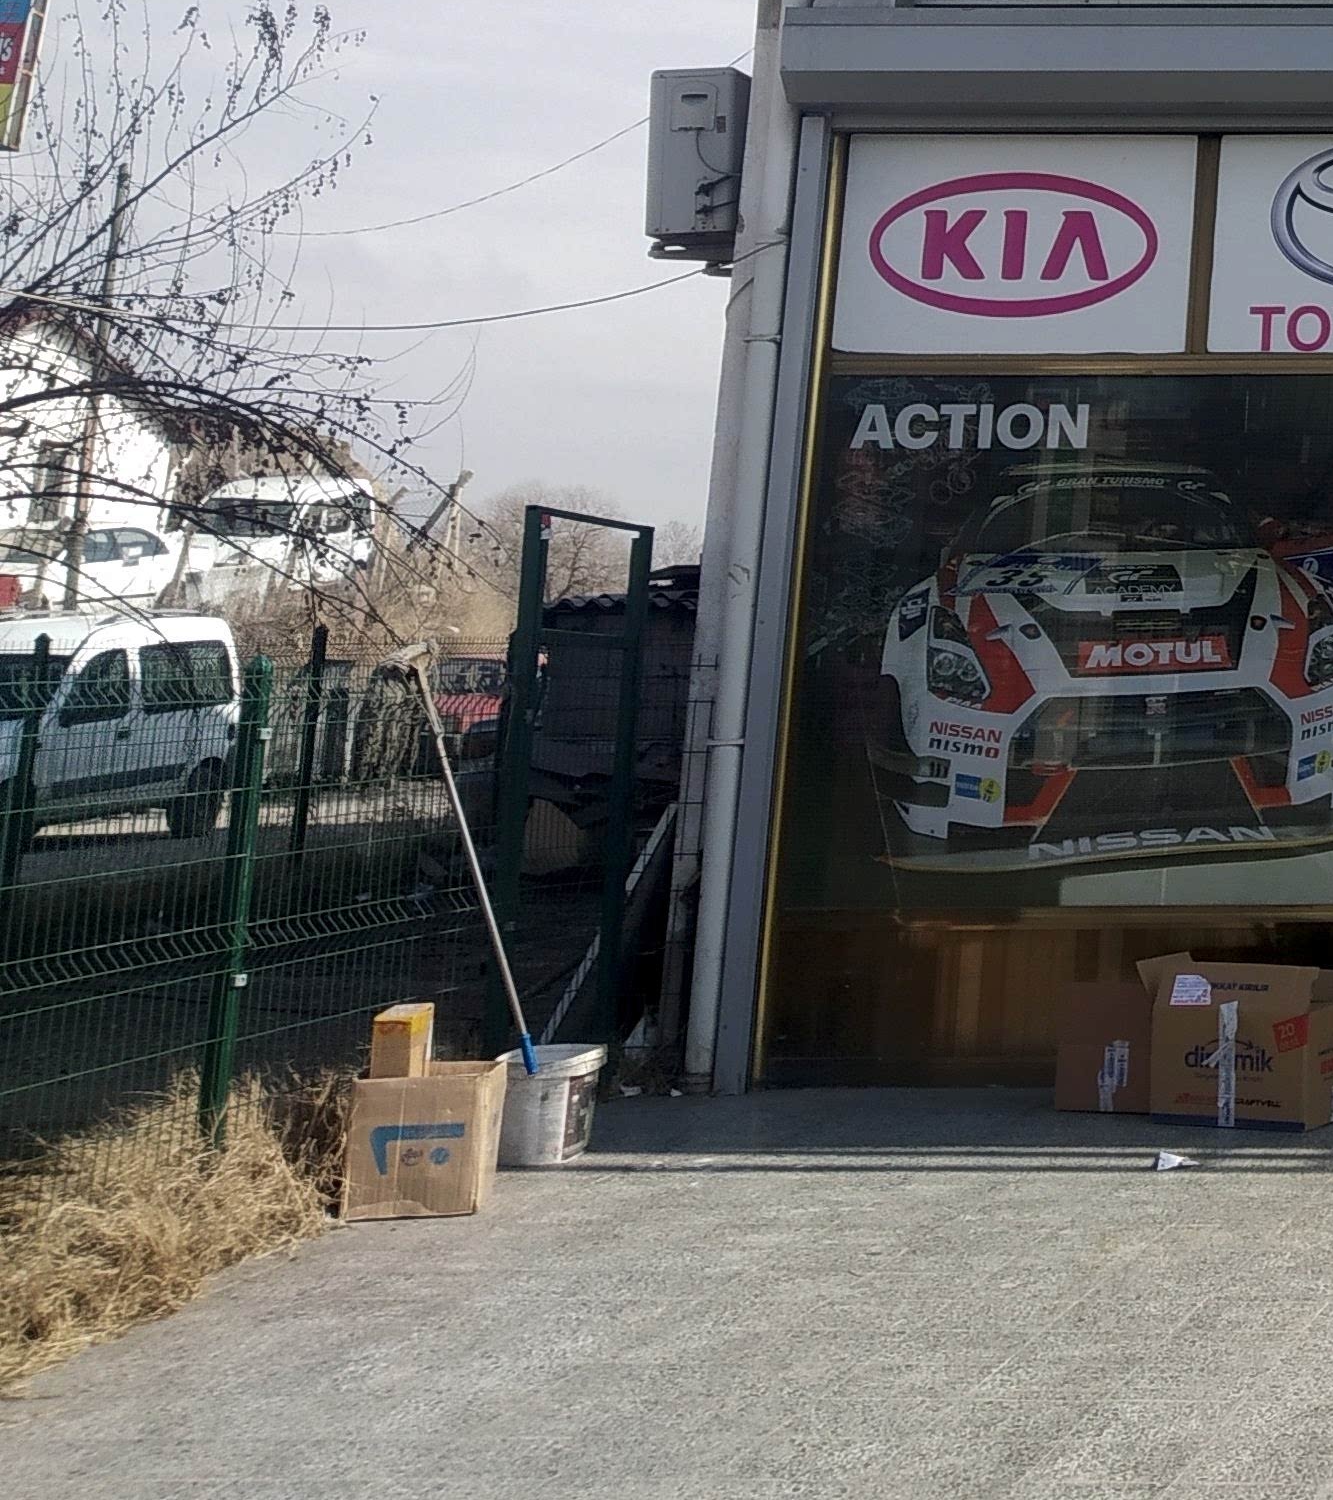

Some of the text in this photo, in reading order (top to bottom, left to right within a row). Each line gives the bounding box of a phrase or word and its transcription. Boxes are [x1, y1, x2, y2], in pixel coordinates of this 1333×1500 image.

[921, 209, 1108, 284] KIA
[850, 403, 1091, 450] ACTION
[986, 570, 1048, 587] 35
[1093, 584, 1177, 595] ACADEMY
[1085, 640, 1222, 669] MOTUL
[929, 720, 1003, 744] NISSAN
[929, 737, 1000, 760] nismo
[1028, 826, 1278, 860] NISSAN
